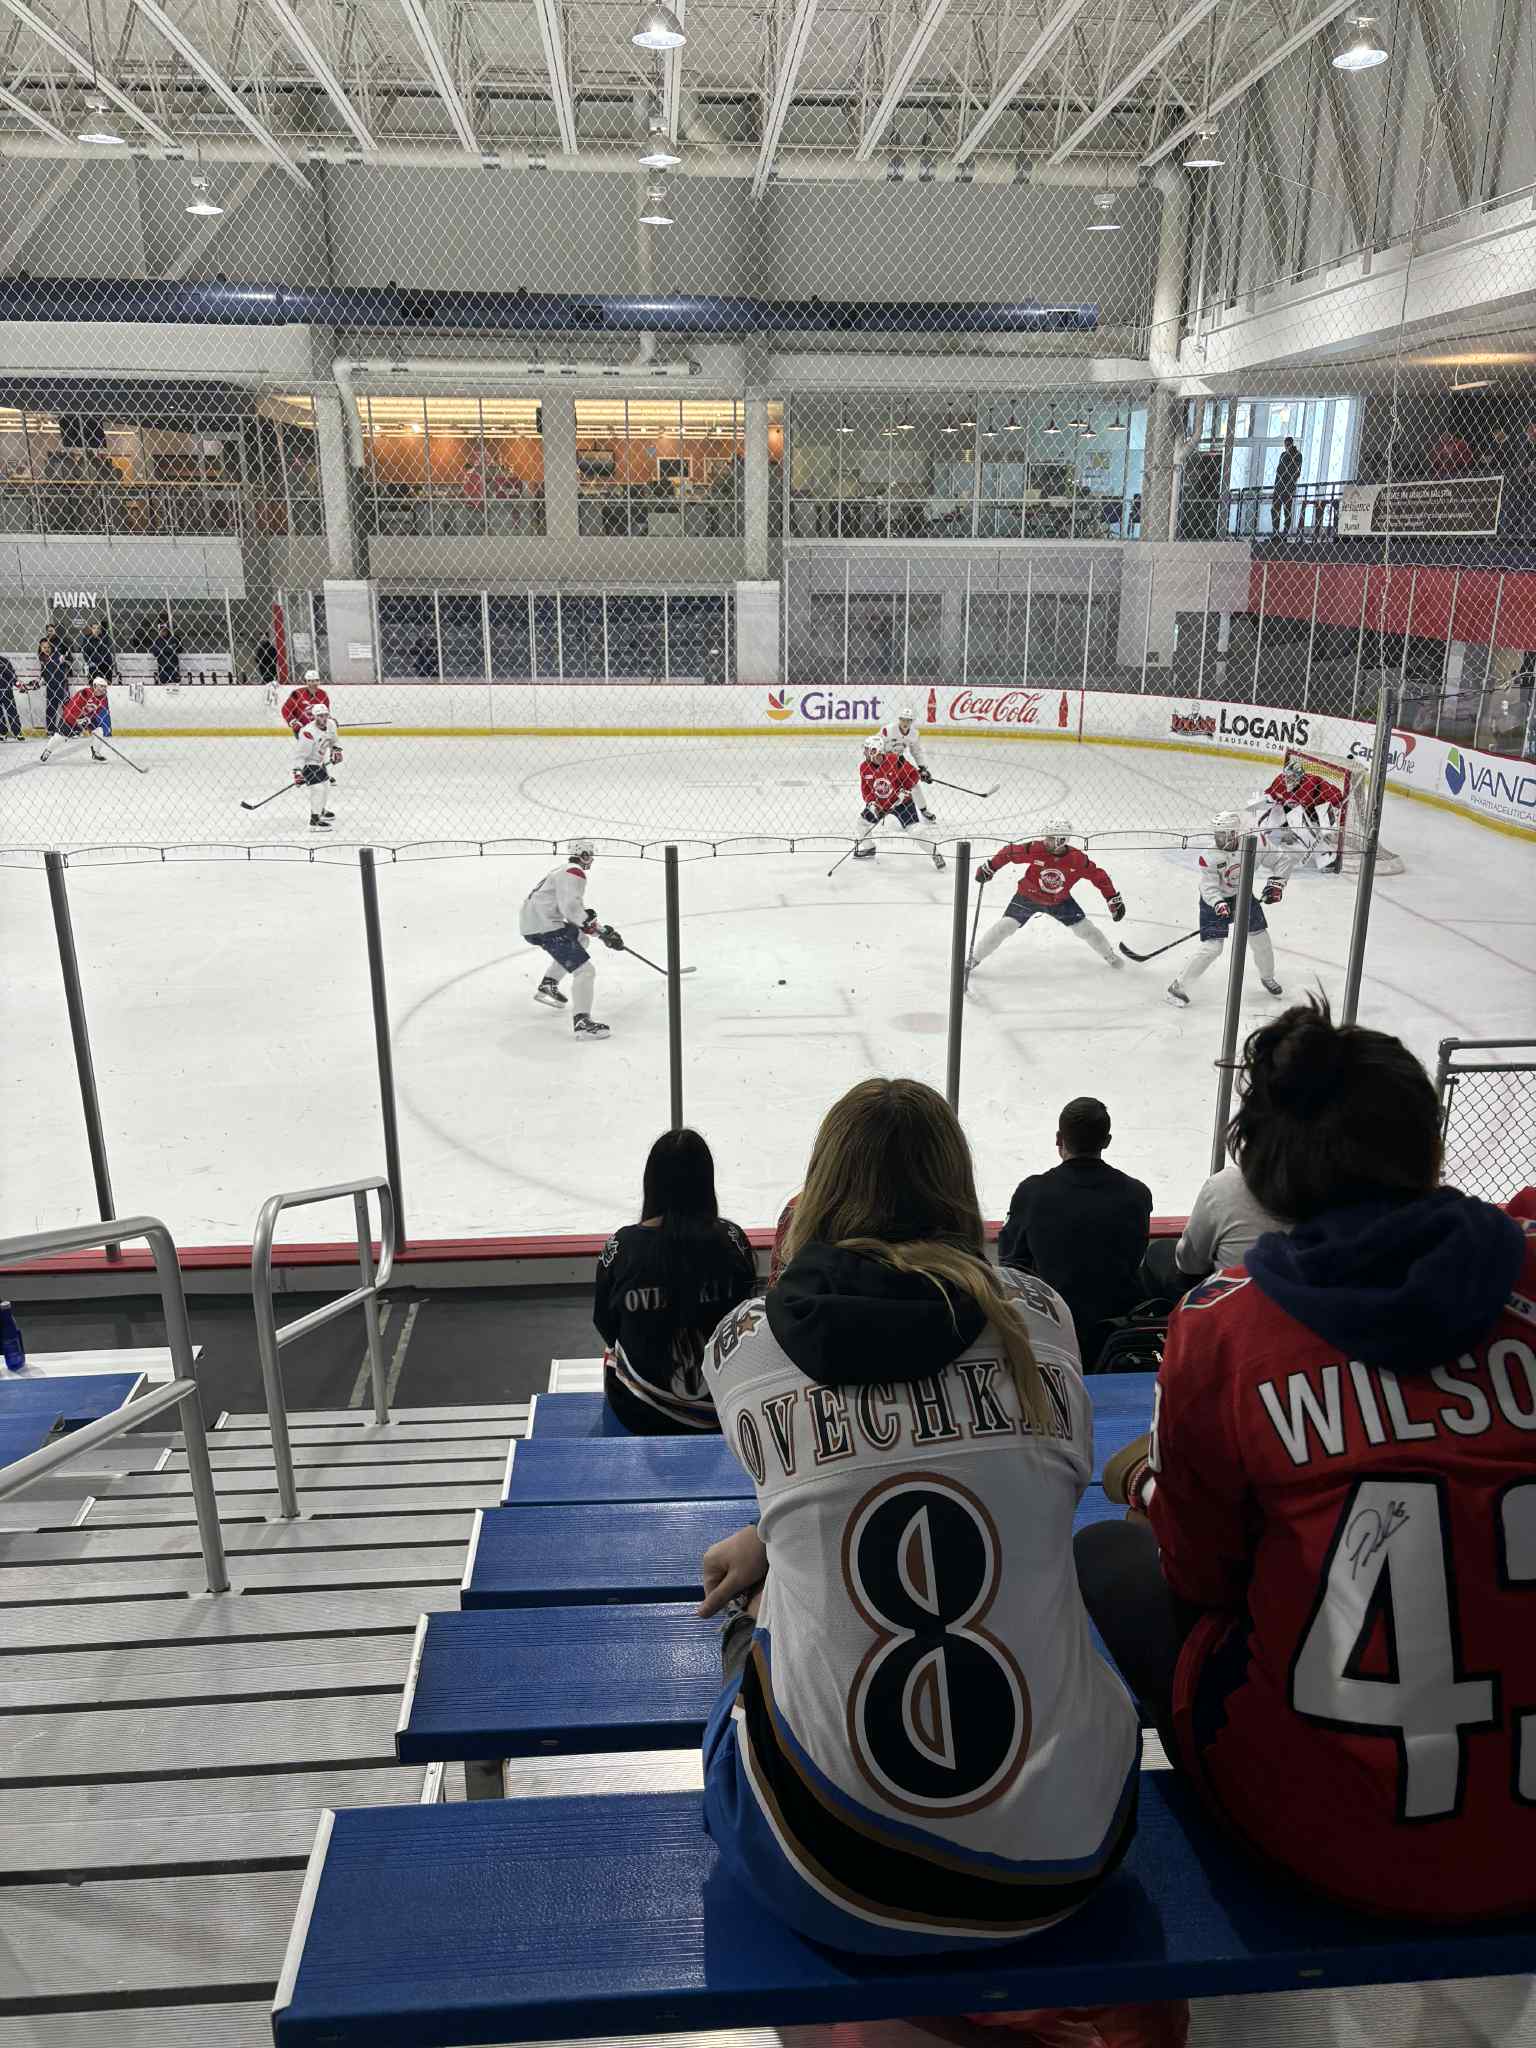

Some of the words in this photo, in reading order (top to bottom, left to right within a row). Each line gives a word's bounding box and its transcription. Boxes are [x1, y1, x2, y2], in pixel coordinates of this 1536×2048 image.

[53, 592, 97, 608] AWAY
[800, 691, 880, 720] Giant
[949, 690, 1044, 723] Coca-Cola
[1219, 708, 1311, 746] LOGAN'S
[736, 1358, 1075, 1486] OVECHKN
[840, 1471, 1033, 1819] 8
